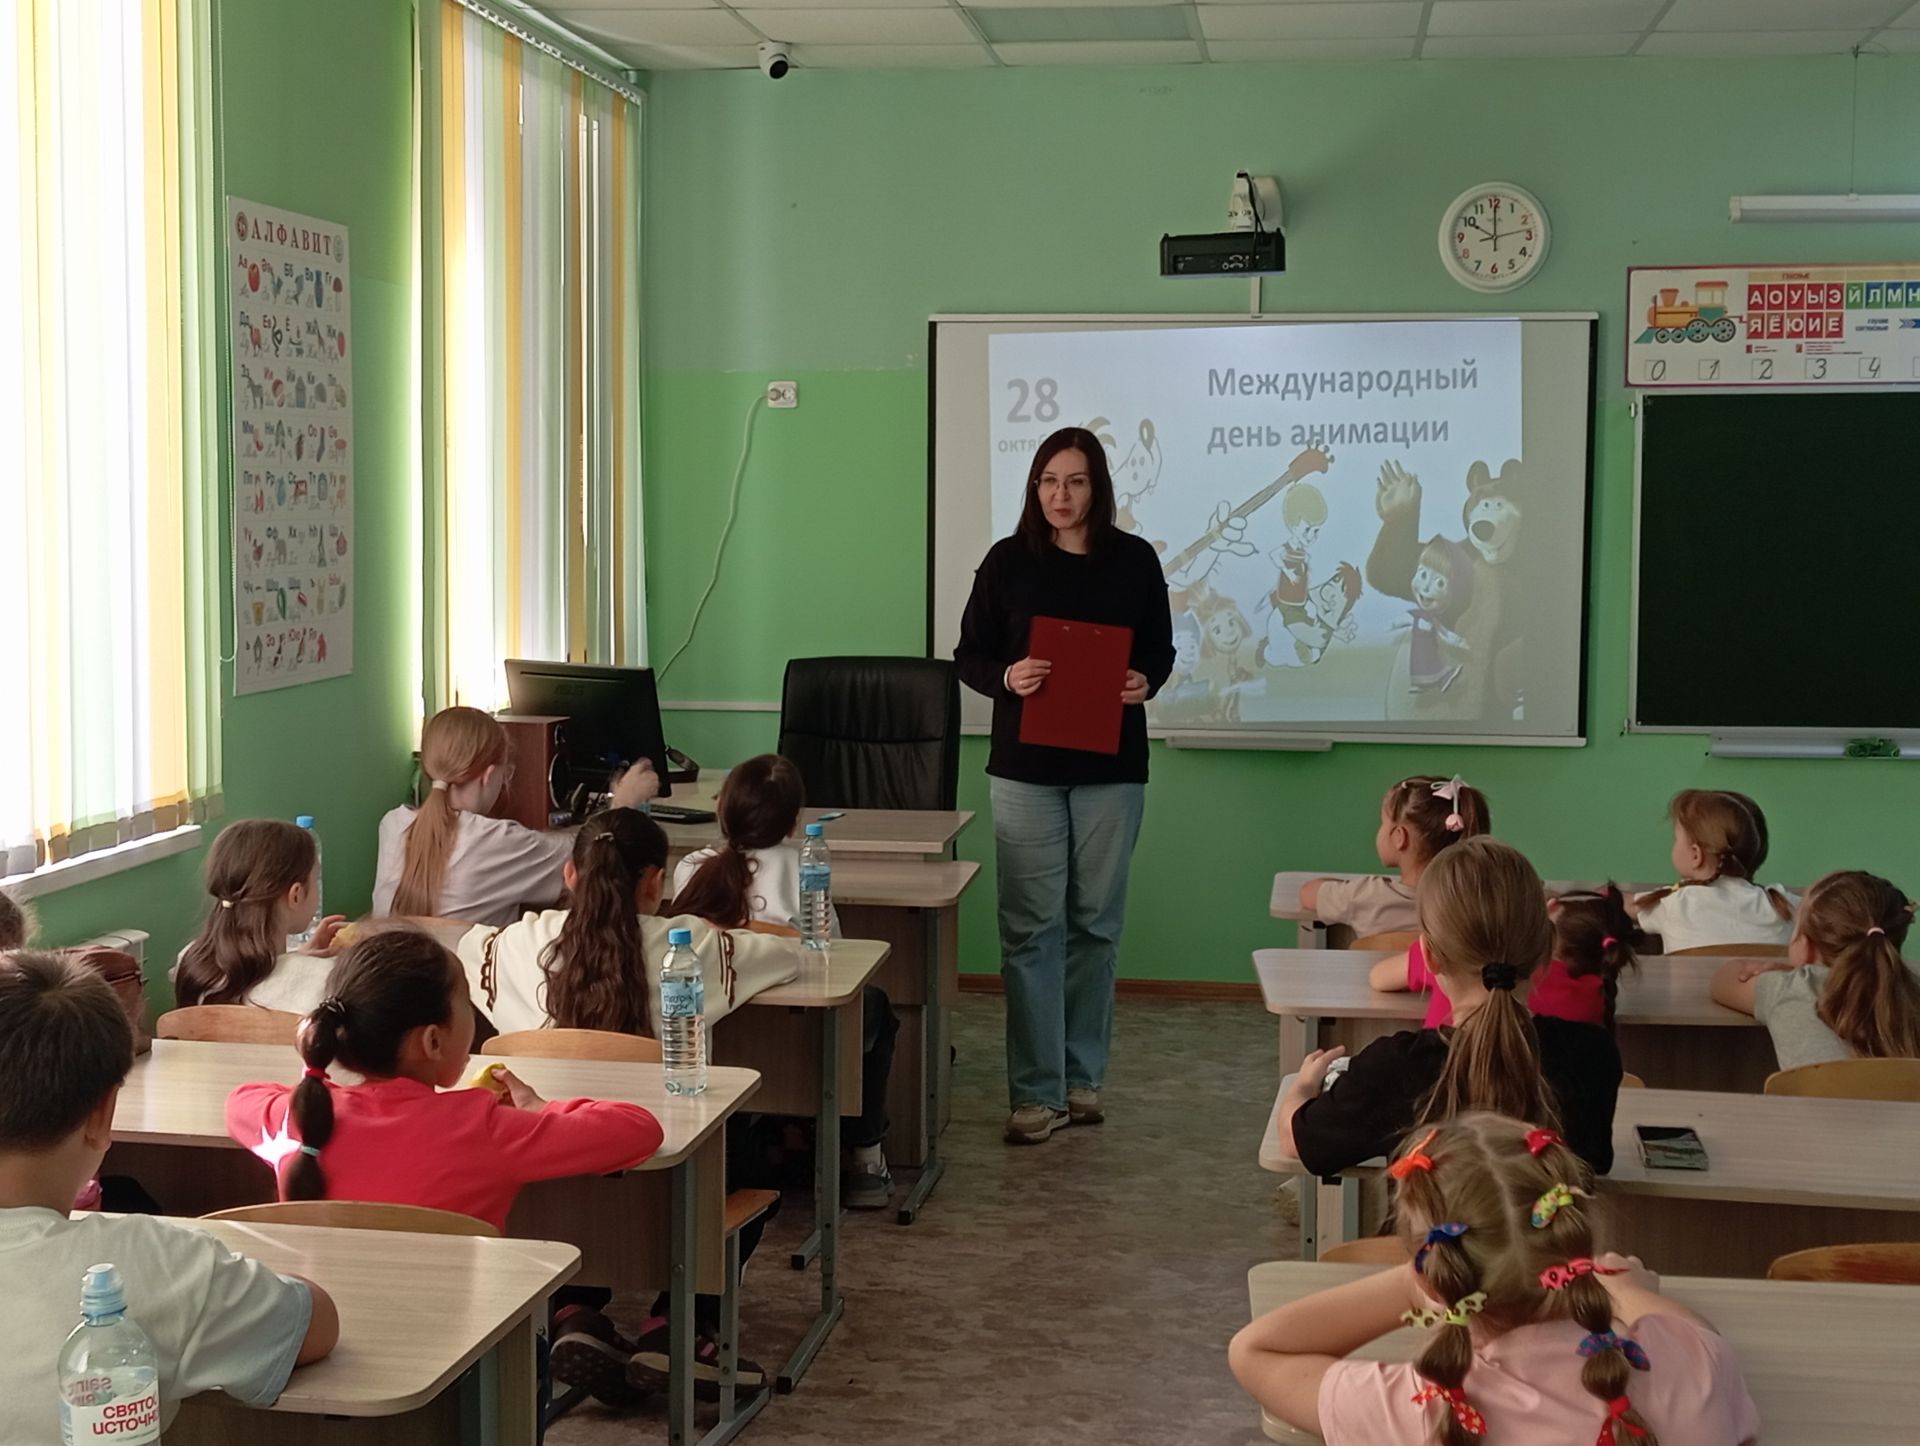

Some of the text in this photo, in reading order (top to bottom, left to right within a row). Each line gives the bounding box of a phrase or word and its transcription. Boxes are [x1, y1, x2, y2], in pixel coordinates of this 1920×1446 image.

[1488, 198, 1501, 209] 12
[1510, 203, 1515, 214] 1
[1474, 204, 1484, 215] 11
[1463, 216, 1476, 227] 10
[1521, 215, 1529, 225] 2
[251, 218, 331, 256] АЛФАВИТ
[1457, 232, 1465, 243] 9
[1525, 230, 1533, 241] 3
[1462, 248, 1470, 259] 8
[1519, 246, 1527, 257] 4
[1474, 260, 1482, 271] 7
[1490, 263, 1498, 274] 6
[1507, 259, 1515, 270] 5
[1749, 286, 1920, 305] А О У Ы Э Й Л М Н
[1749, 319, 1762, 332] Я
[1769, 314, 1781, 332] Ё
[1786, 318, 1804, 332] Ю
[1808, 318, 1821, 332] И
[1828, 317, 1840, 331] Е
[1651, 357, 1881, 381] 0 1 2 3 4
[1208, 358, 1478, 401] Международный
[1007, 377, 1060, 423] 28
[1207, 421, 1449, 454] день анимации
[92, 1408, 159, 1435] ИСТОЧН
